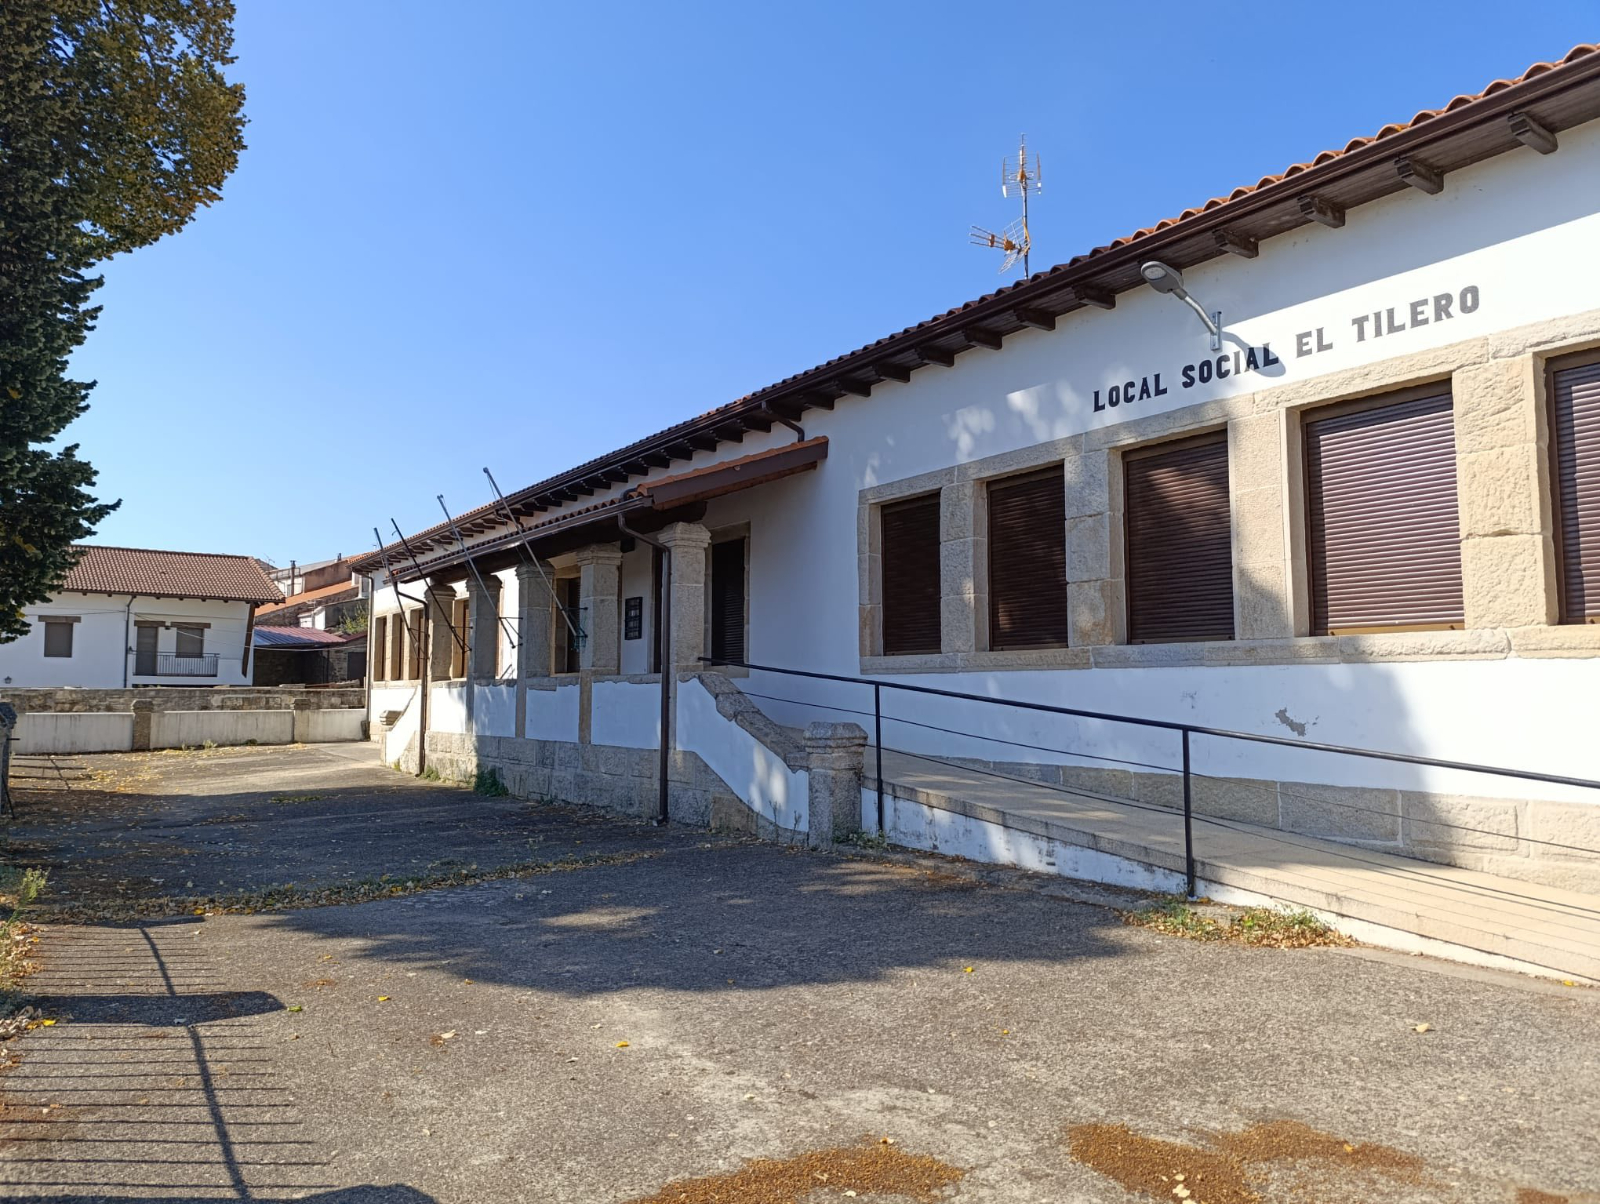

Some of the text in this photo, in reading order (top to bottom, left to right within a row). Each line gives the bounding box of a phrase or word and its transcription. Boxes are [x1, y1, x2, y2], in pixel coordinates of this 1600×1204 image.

[1092, 285, 1480, 413] LOCAL SOCIAL EL TILERO
